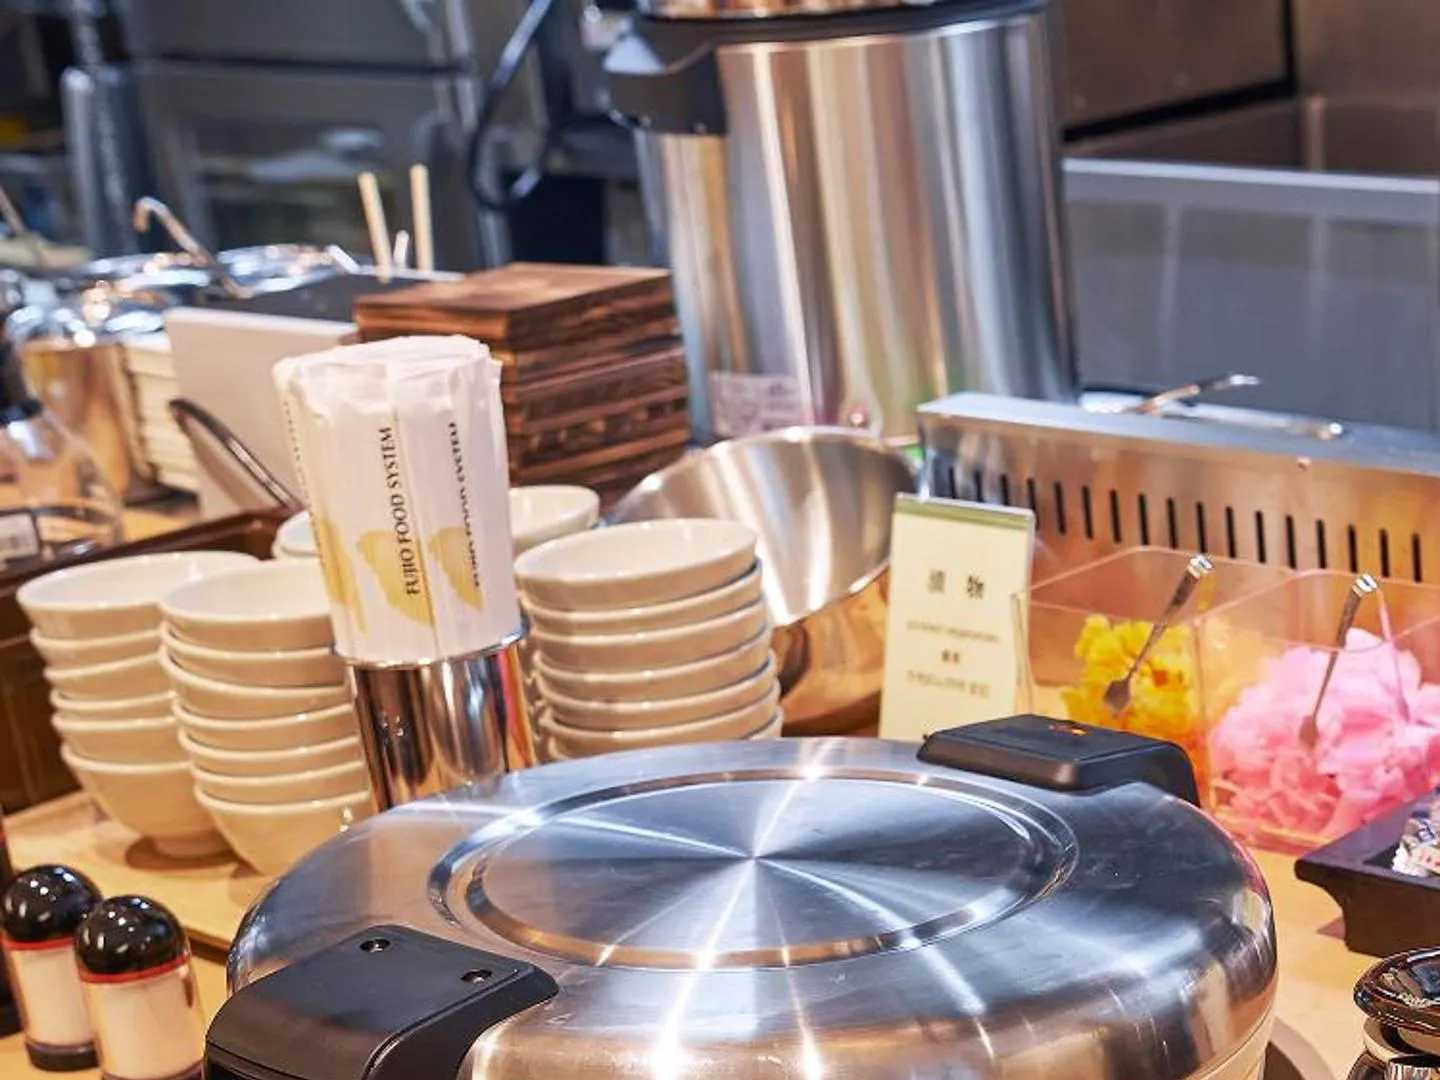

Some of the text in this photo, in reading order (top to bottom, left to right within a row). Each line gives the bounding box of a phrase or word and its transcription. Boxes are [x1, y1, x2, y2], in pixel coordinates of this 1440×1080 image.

[378, 426, 421, 595] FUJIO FOOD SYSTEM
